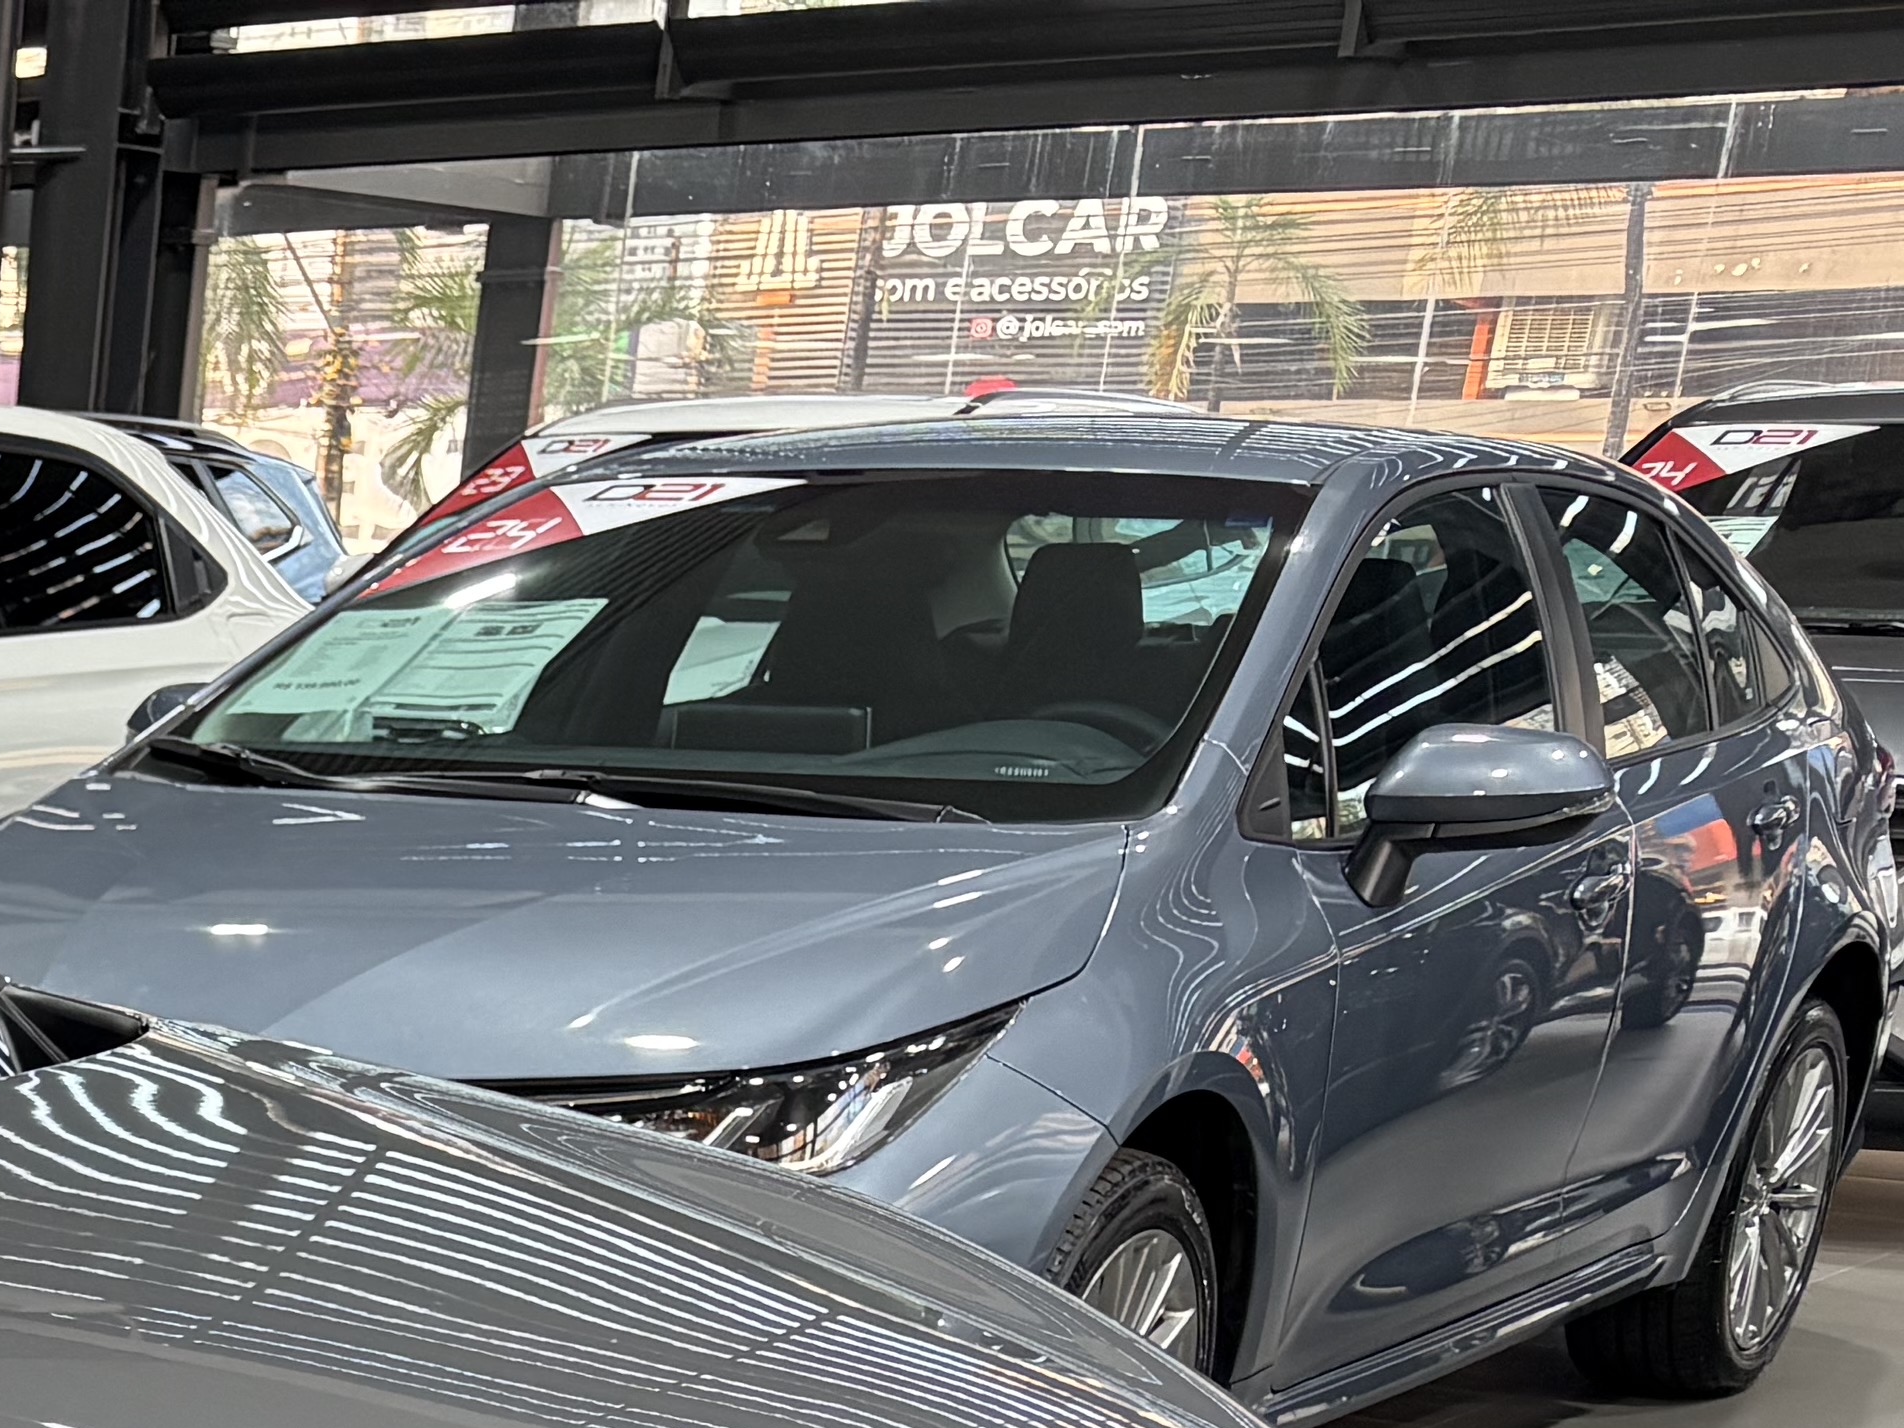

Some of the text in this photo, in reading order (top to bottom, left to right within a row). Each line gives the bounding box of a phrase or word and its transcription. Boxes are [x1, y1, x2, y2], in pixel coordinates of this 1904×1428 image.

[882, 196, 1168, 257] JOLCAR
[1710, 429, 1820, 446] D21
[584, 482, 727, 502] D21
